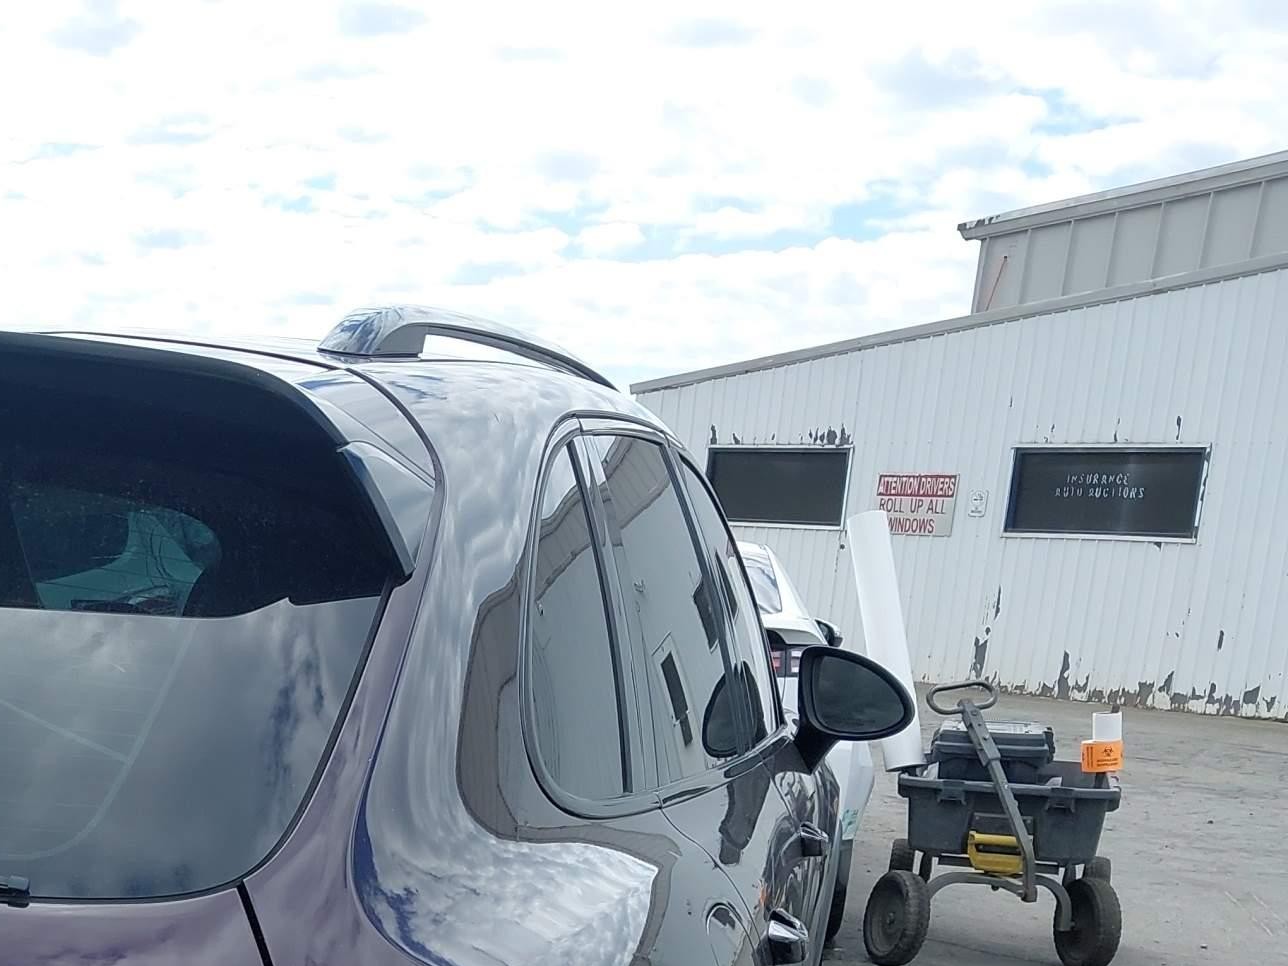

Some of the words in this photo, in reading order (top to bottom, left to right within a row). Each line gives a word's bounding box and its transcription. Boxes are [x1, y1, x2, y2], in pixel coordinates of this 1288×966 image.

[878, 477, 919, 495] ATTENTION
[919, 477, 955, 496] DRIVERS
[1066, 473, 1130, 485] INSURANCE
[879, 497, 904, 513] ROLL
[910, 498, 923, 514] UP
[926, 499, 945, 515] ALL
